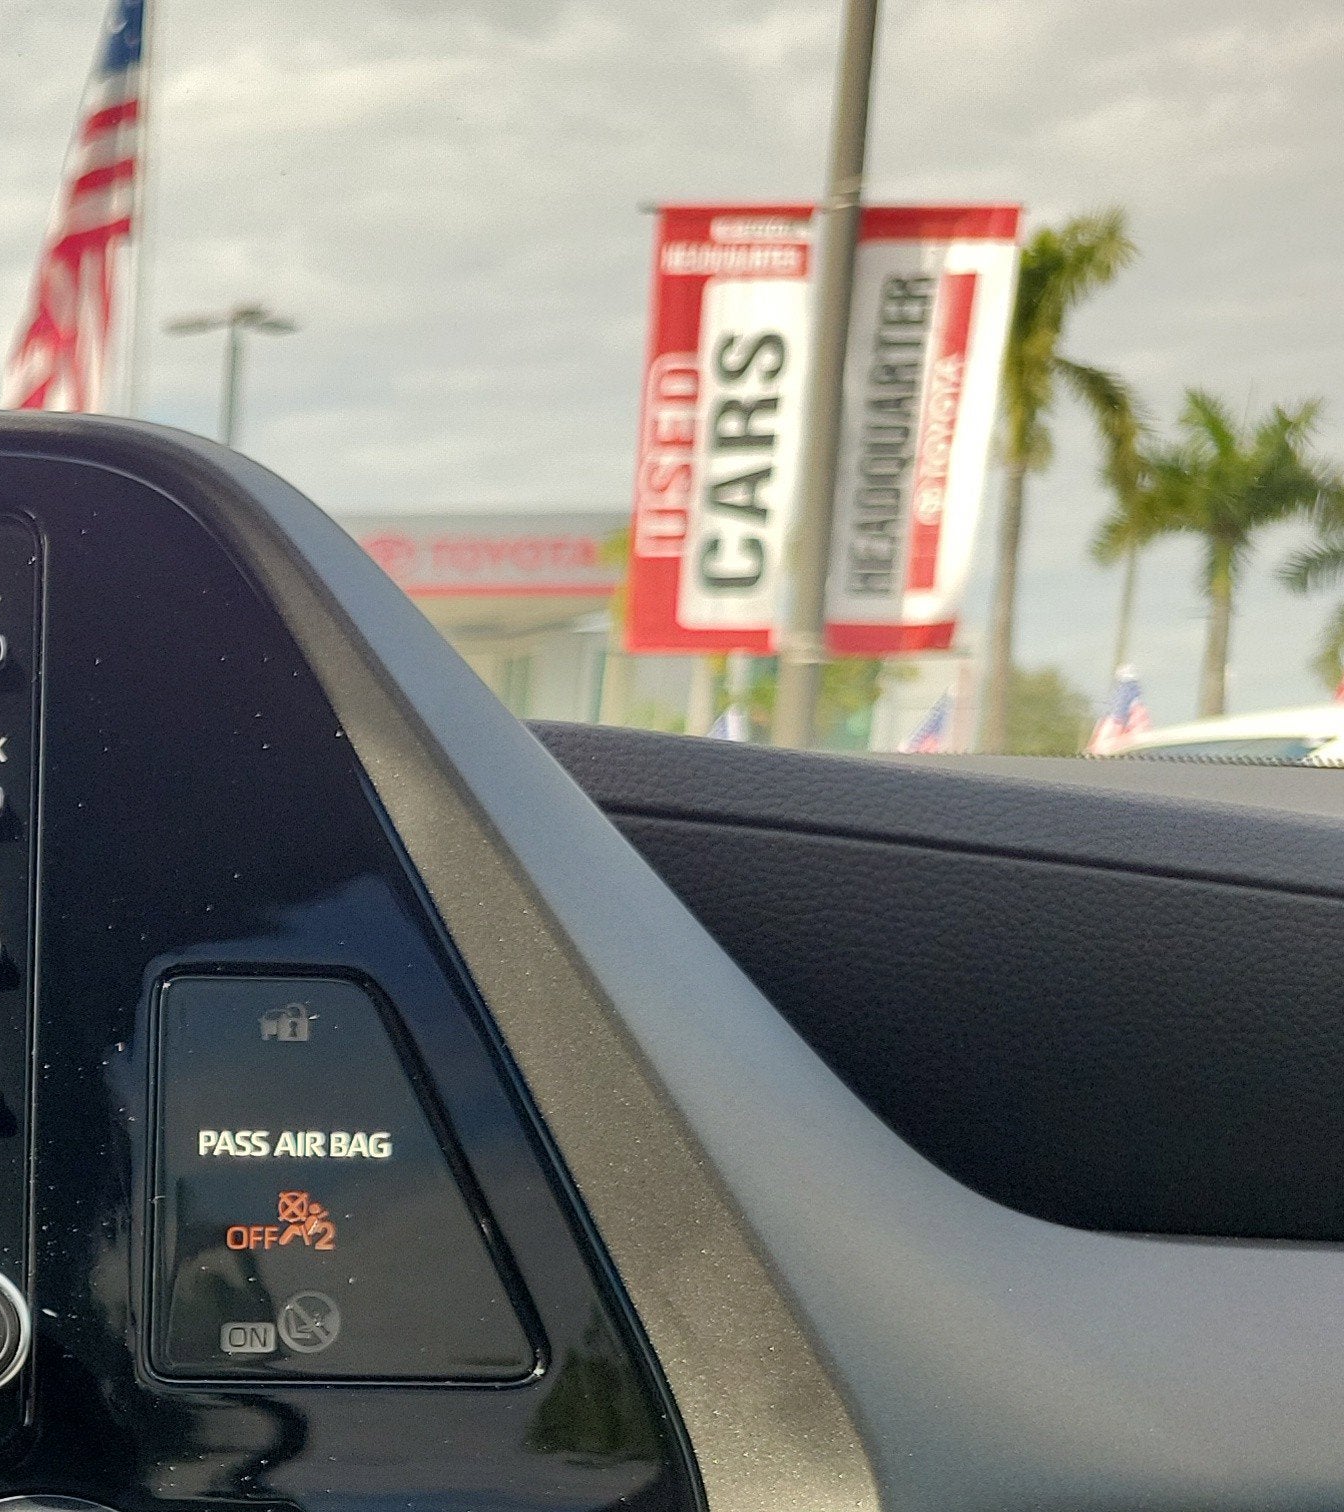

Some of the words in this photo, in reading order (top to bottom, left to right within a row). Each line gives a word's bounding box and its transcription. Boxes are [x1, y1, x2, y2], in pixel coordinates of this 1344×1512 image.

[850, 272, 936, 595] HEADQUARTER
[642, 367, 701, 540] USED
[700, 330, 787, 589] CARS
[433, 537, 597, 570] TOYOTA
[198, 1130, 270, 1158] PASS
[273, 1131, 326, 1158] AIR
[329, 1132, 393, 1159] BAG
[226, 1225, 279, 1251] OFF
[227, 1325, 270, 1348] ON
